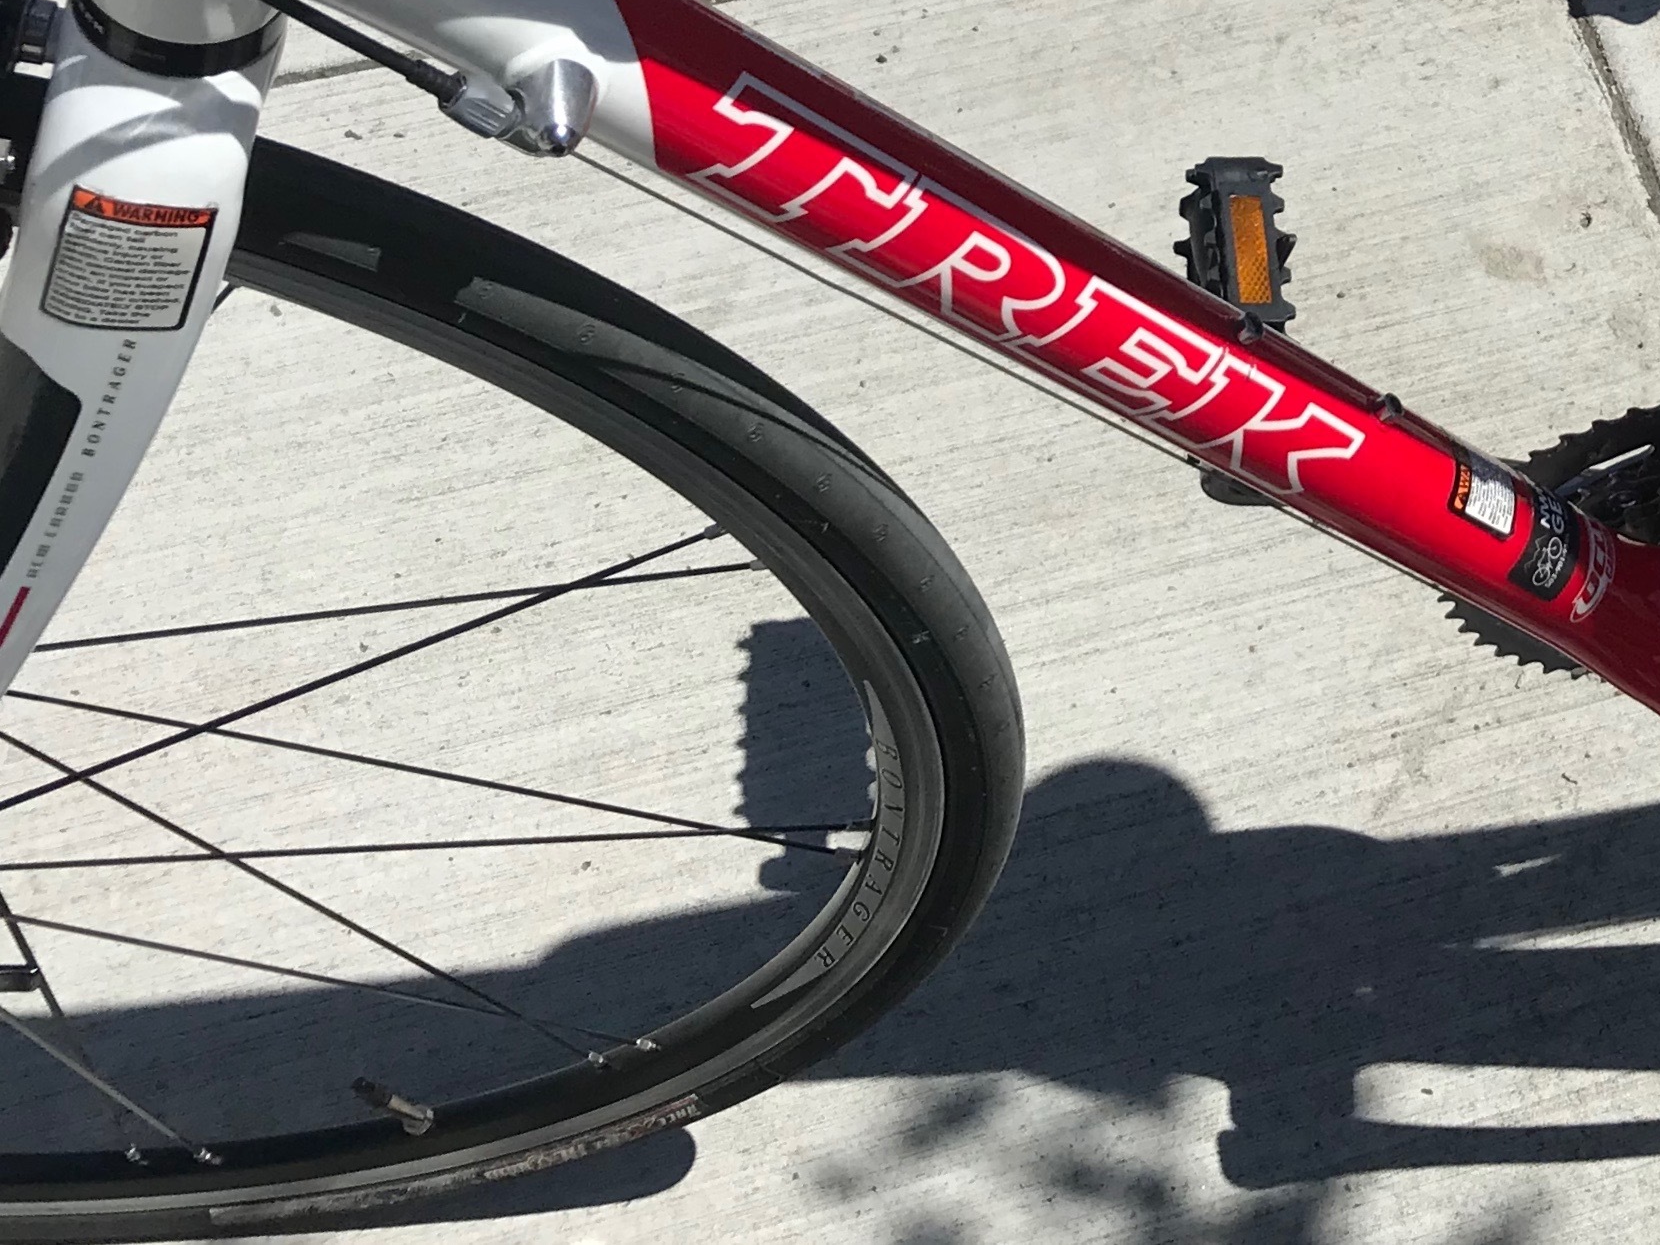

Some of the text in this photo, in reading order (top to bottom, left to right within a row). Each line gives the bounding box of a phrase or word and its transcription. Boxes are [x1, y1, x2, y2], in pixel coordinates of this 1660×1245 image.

[113, 203, 200, 223] WARNING
[688, 70, 1366, 497] TREK
[81, 338, 137, 457] BONTRAGER
[816, 738, 903, 968] BONTRAGER
